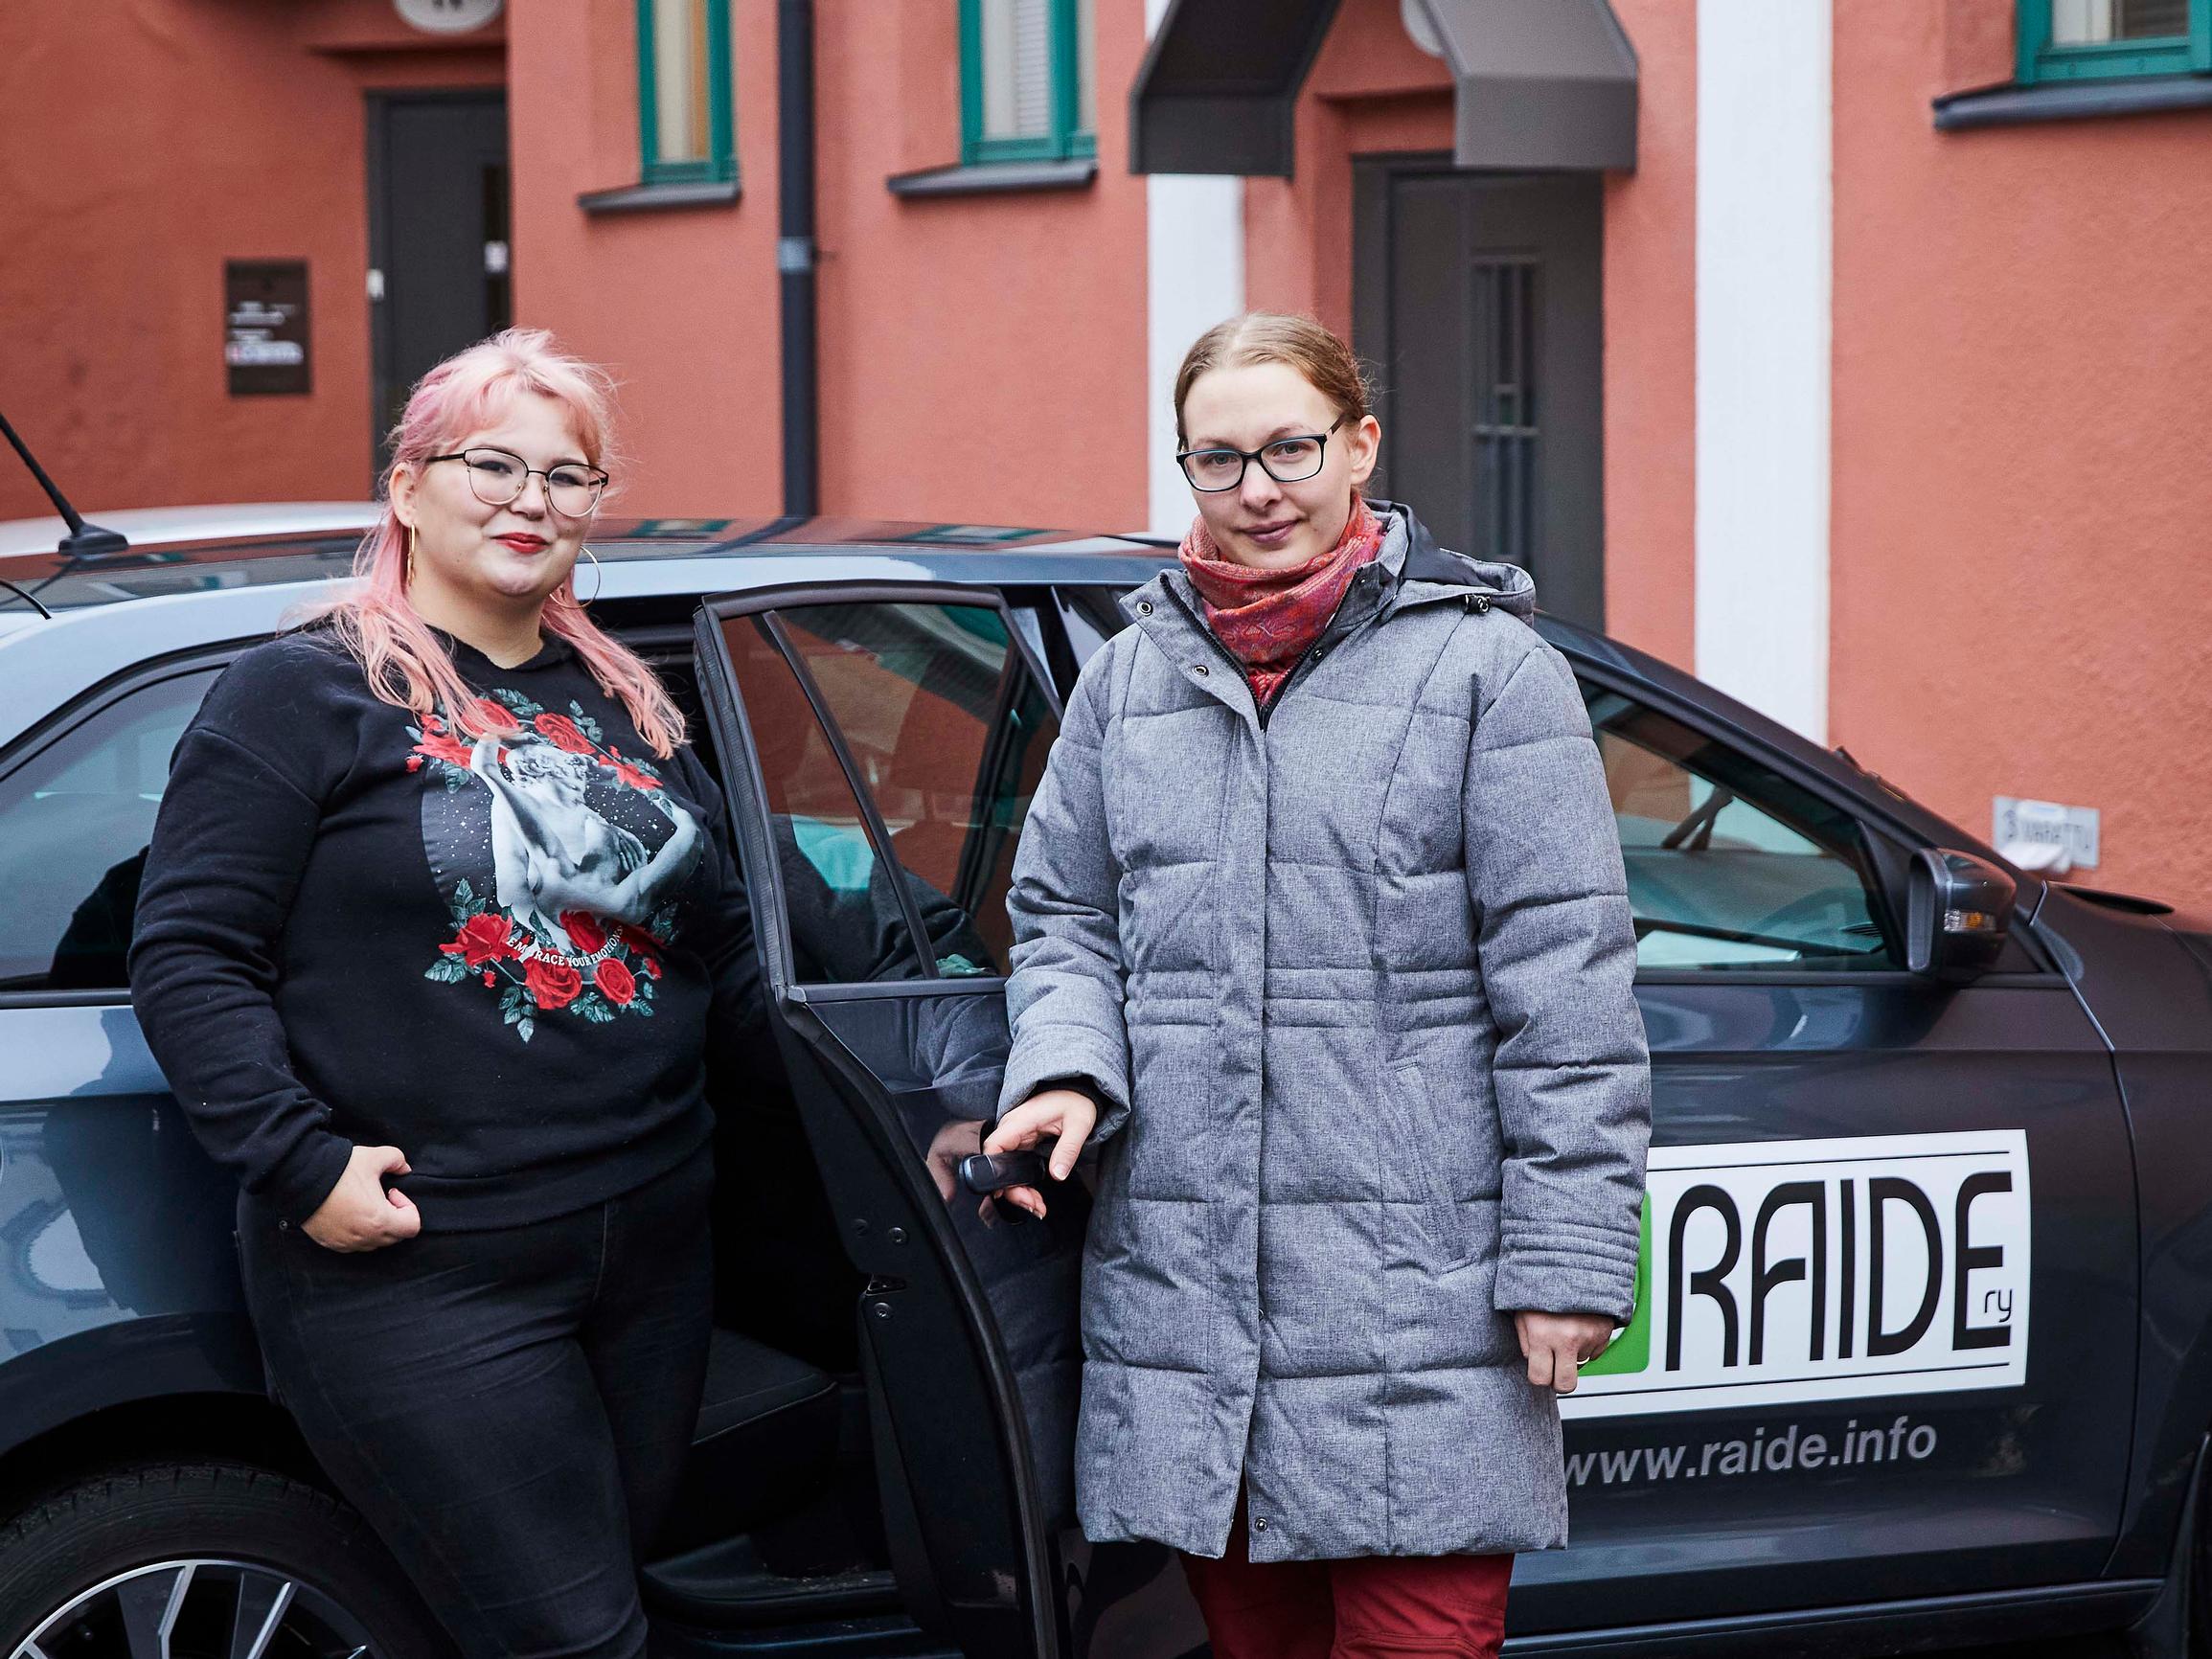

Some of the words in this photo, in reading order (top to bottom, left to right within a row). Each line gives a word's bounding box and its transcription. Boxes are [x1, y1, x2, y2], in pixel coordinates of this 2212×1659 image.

[506, 938, 565, 966] EMRACE
[566, 955, 592, 967] YOUR
[1665, 1170, 2013, 1372] RAIDE
[1984, 1288, 2013, 1323] ry
[1564, 1416, 1937, 1486] www.raide.info
